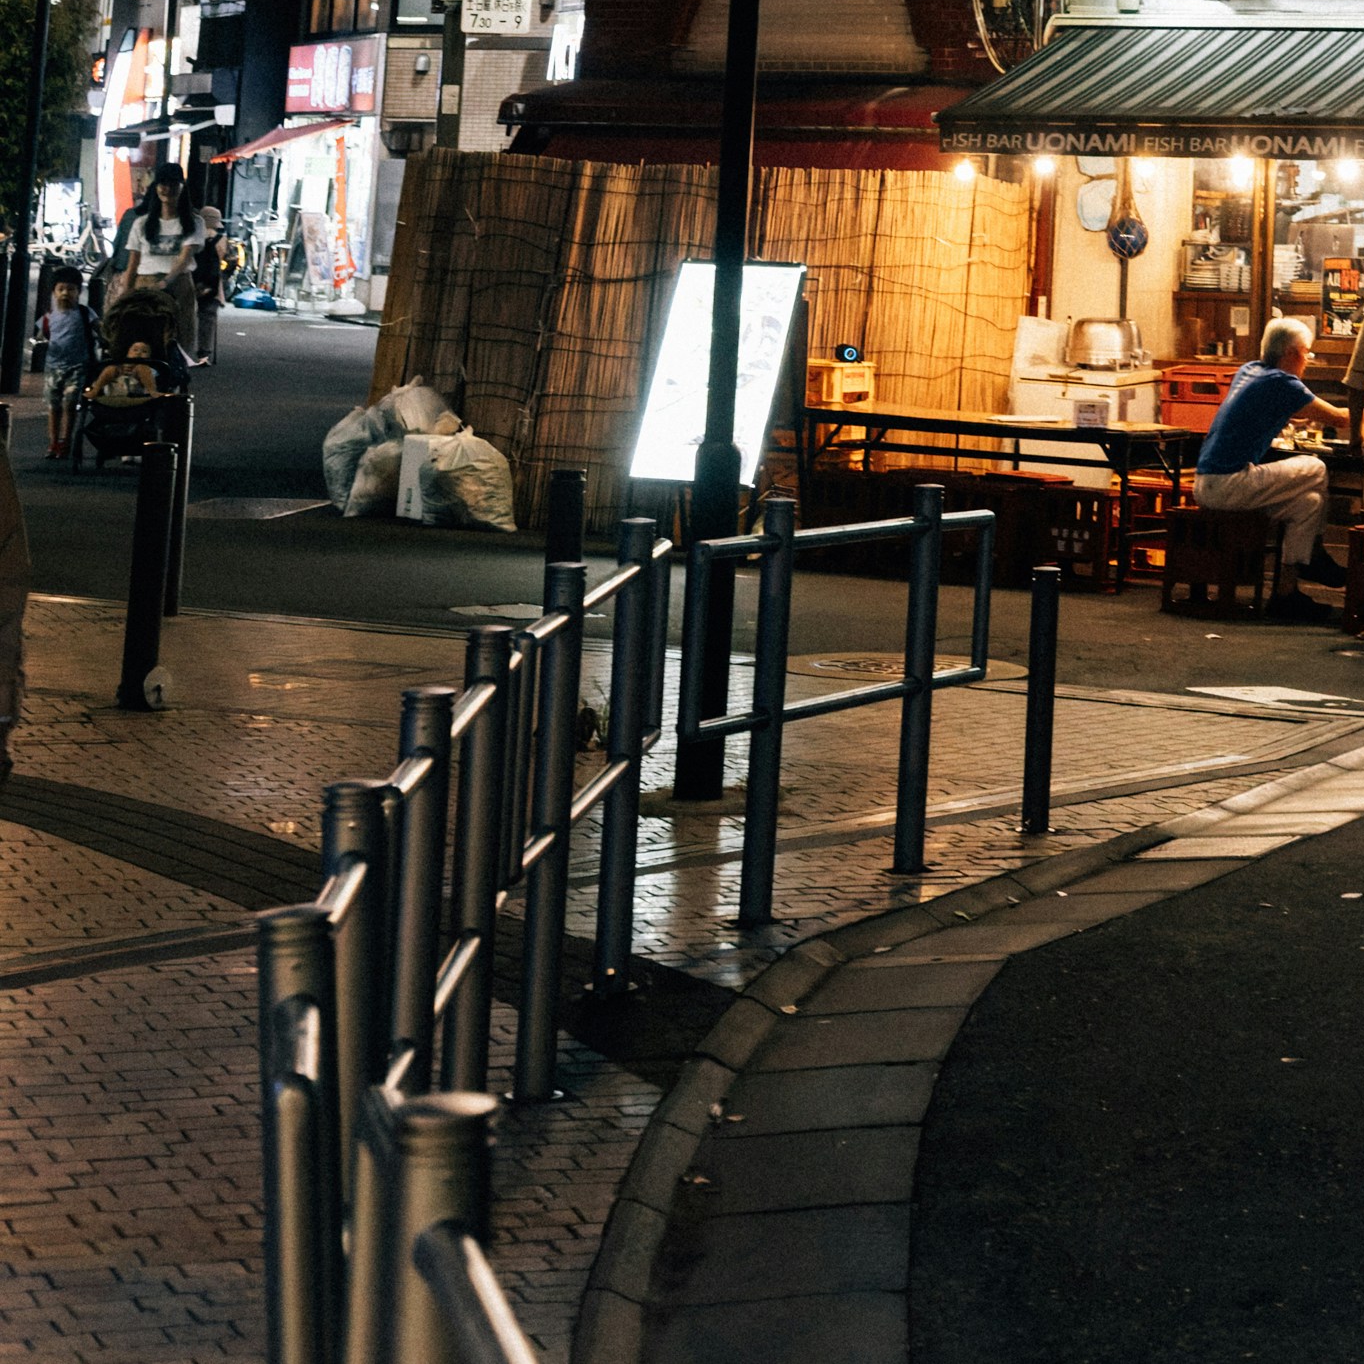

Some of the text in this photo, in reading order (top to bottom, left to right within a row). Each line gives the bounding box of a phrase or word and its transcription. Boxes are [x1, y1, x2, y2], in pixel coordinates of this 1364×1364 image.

[986, 134, 1022, 149] BAR
[1026, 133, 1137, 152] UONAMI
[1144, 136, 1184, 152] FISH
[1189, 136, 1228, 153] BAR
